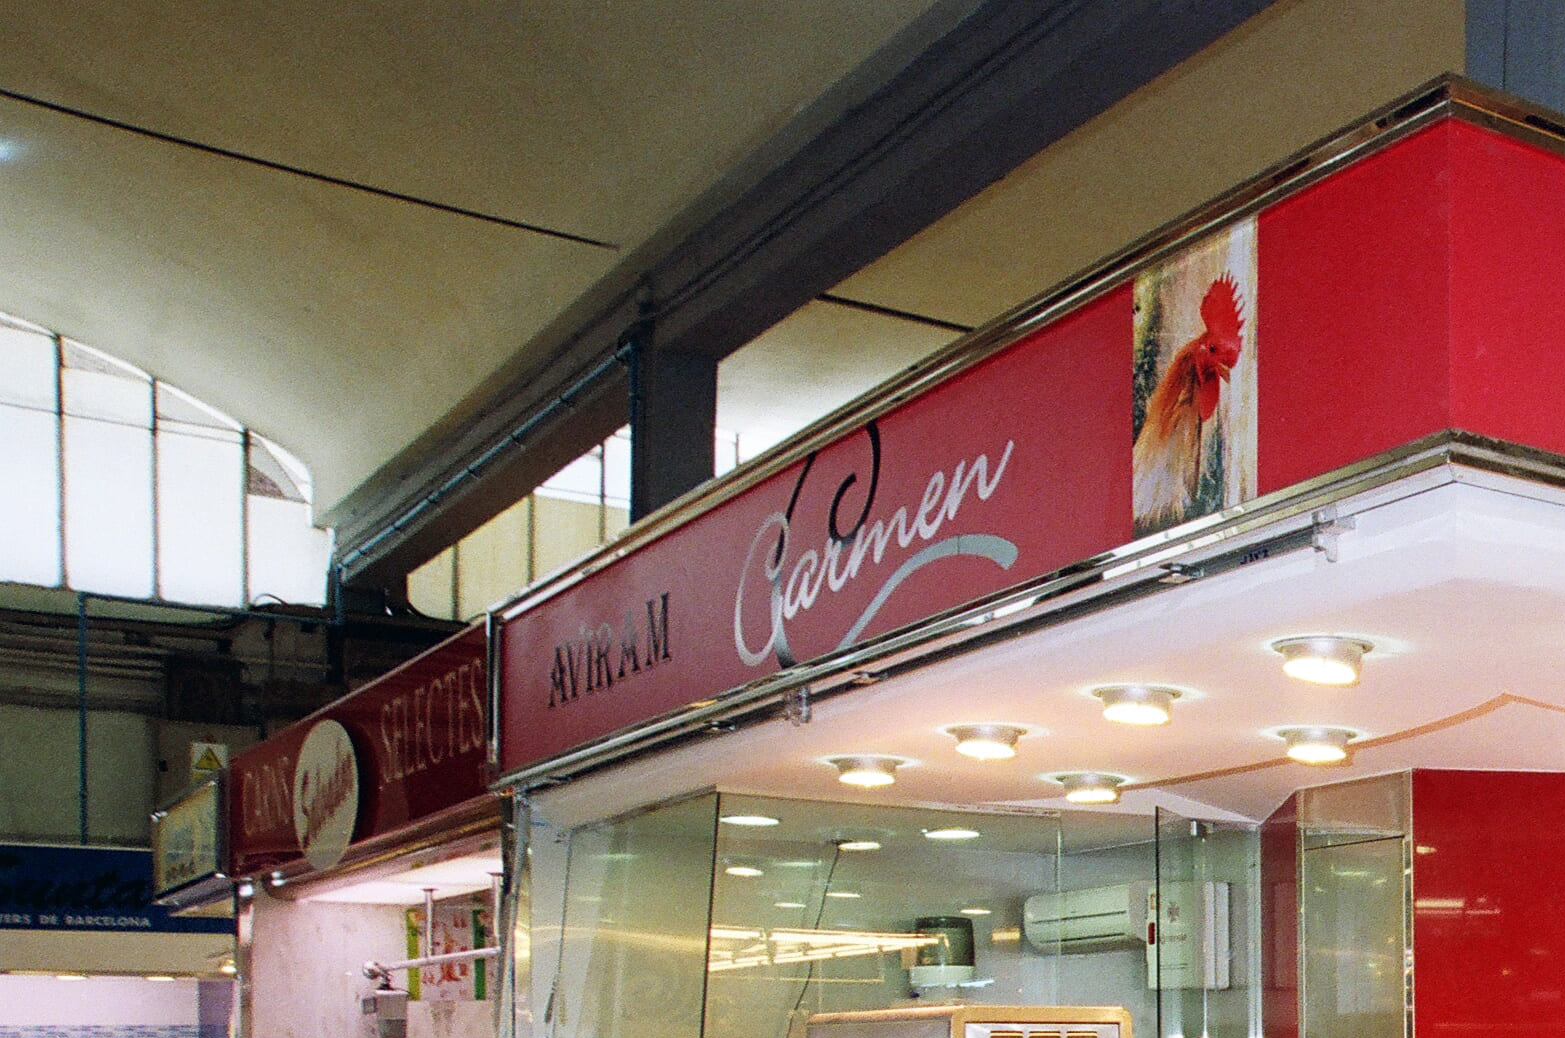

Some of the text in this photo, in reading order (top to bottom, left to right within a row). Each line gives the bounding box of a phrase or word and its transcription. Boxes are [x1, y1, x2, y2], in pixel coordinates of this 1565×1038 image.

[733, 438, 1016, 668] Carmen
[548, 591, 672, 709] AVIRAM
[381, 657, 484, 784] SELECTES
[38, 914, 60, 925] DE
[64, 914, 152, 928] BARCELONA
